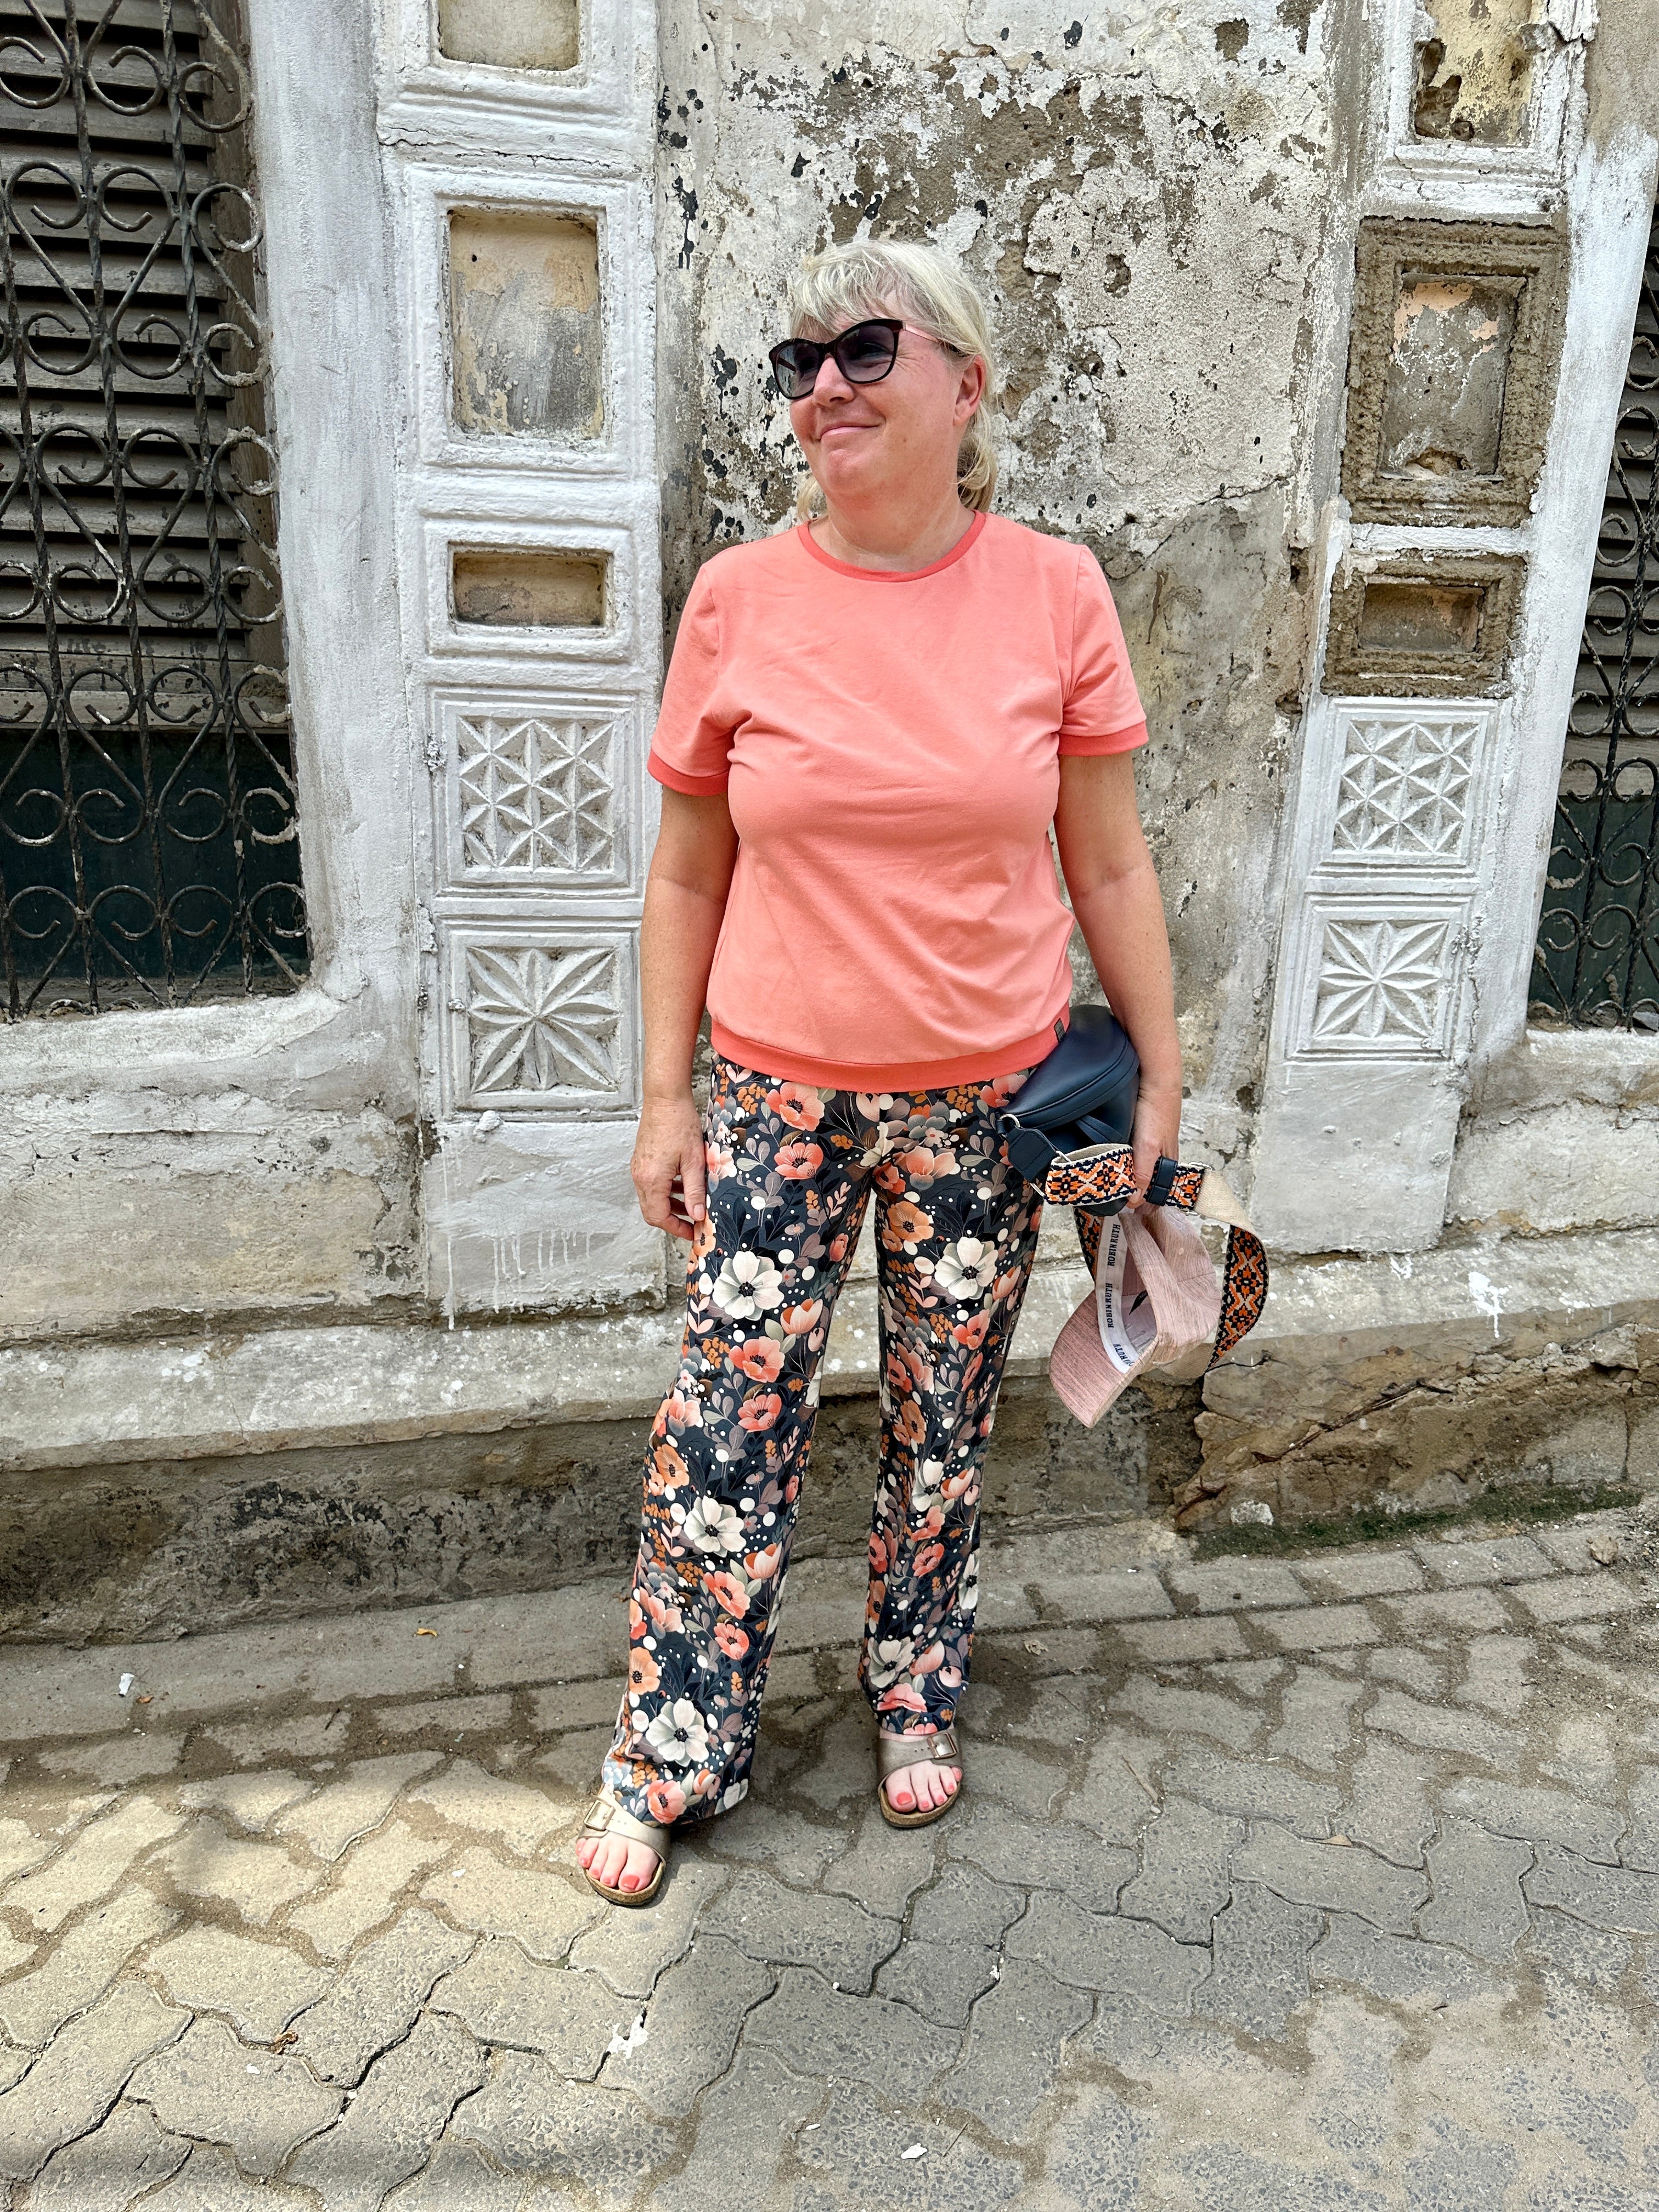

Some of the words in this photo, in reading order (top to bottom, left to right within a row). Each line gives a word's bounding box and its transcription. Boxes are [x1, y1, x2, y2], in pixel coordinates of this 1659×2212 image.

[1110, 1223, 1120, 1243] RUTH
[1108, 1243, 1117, 1267] ROBIN
[1105, 1305, 1114, 1328] ROBIN
